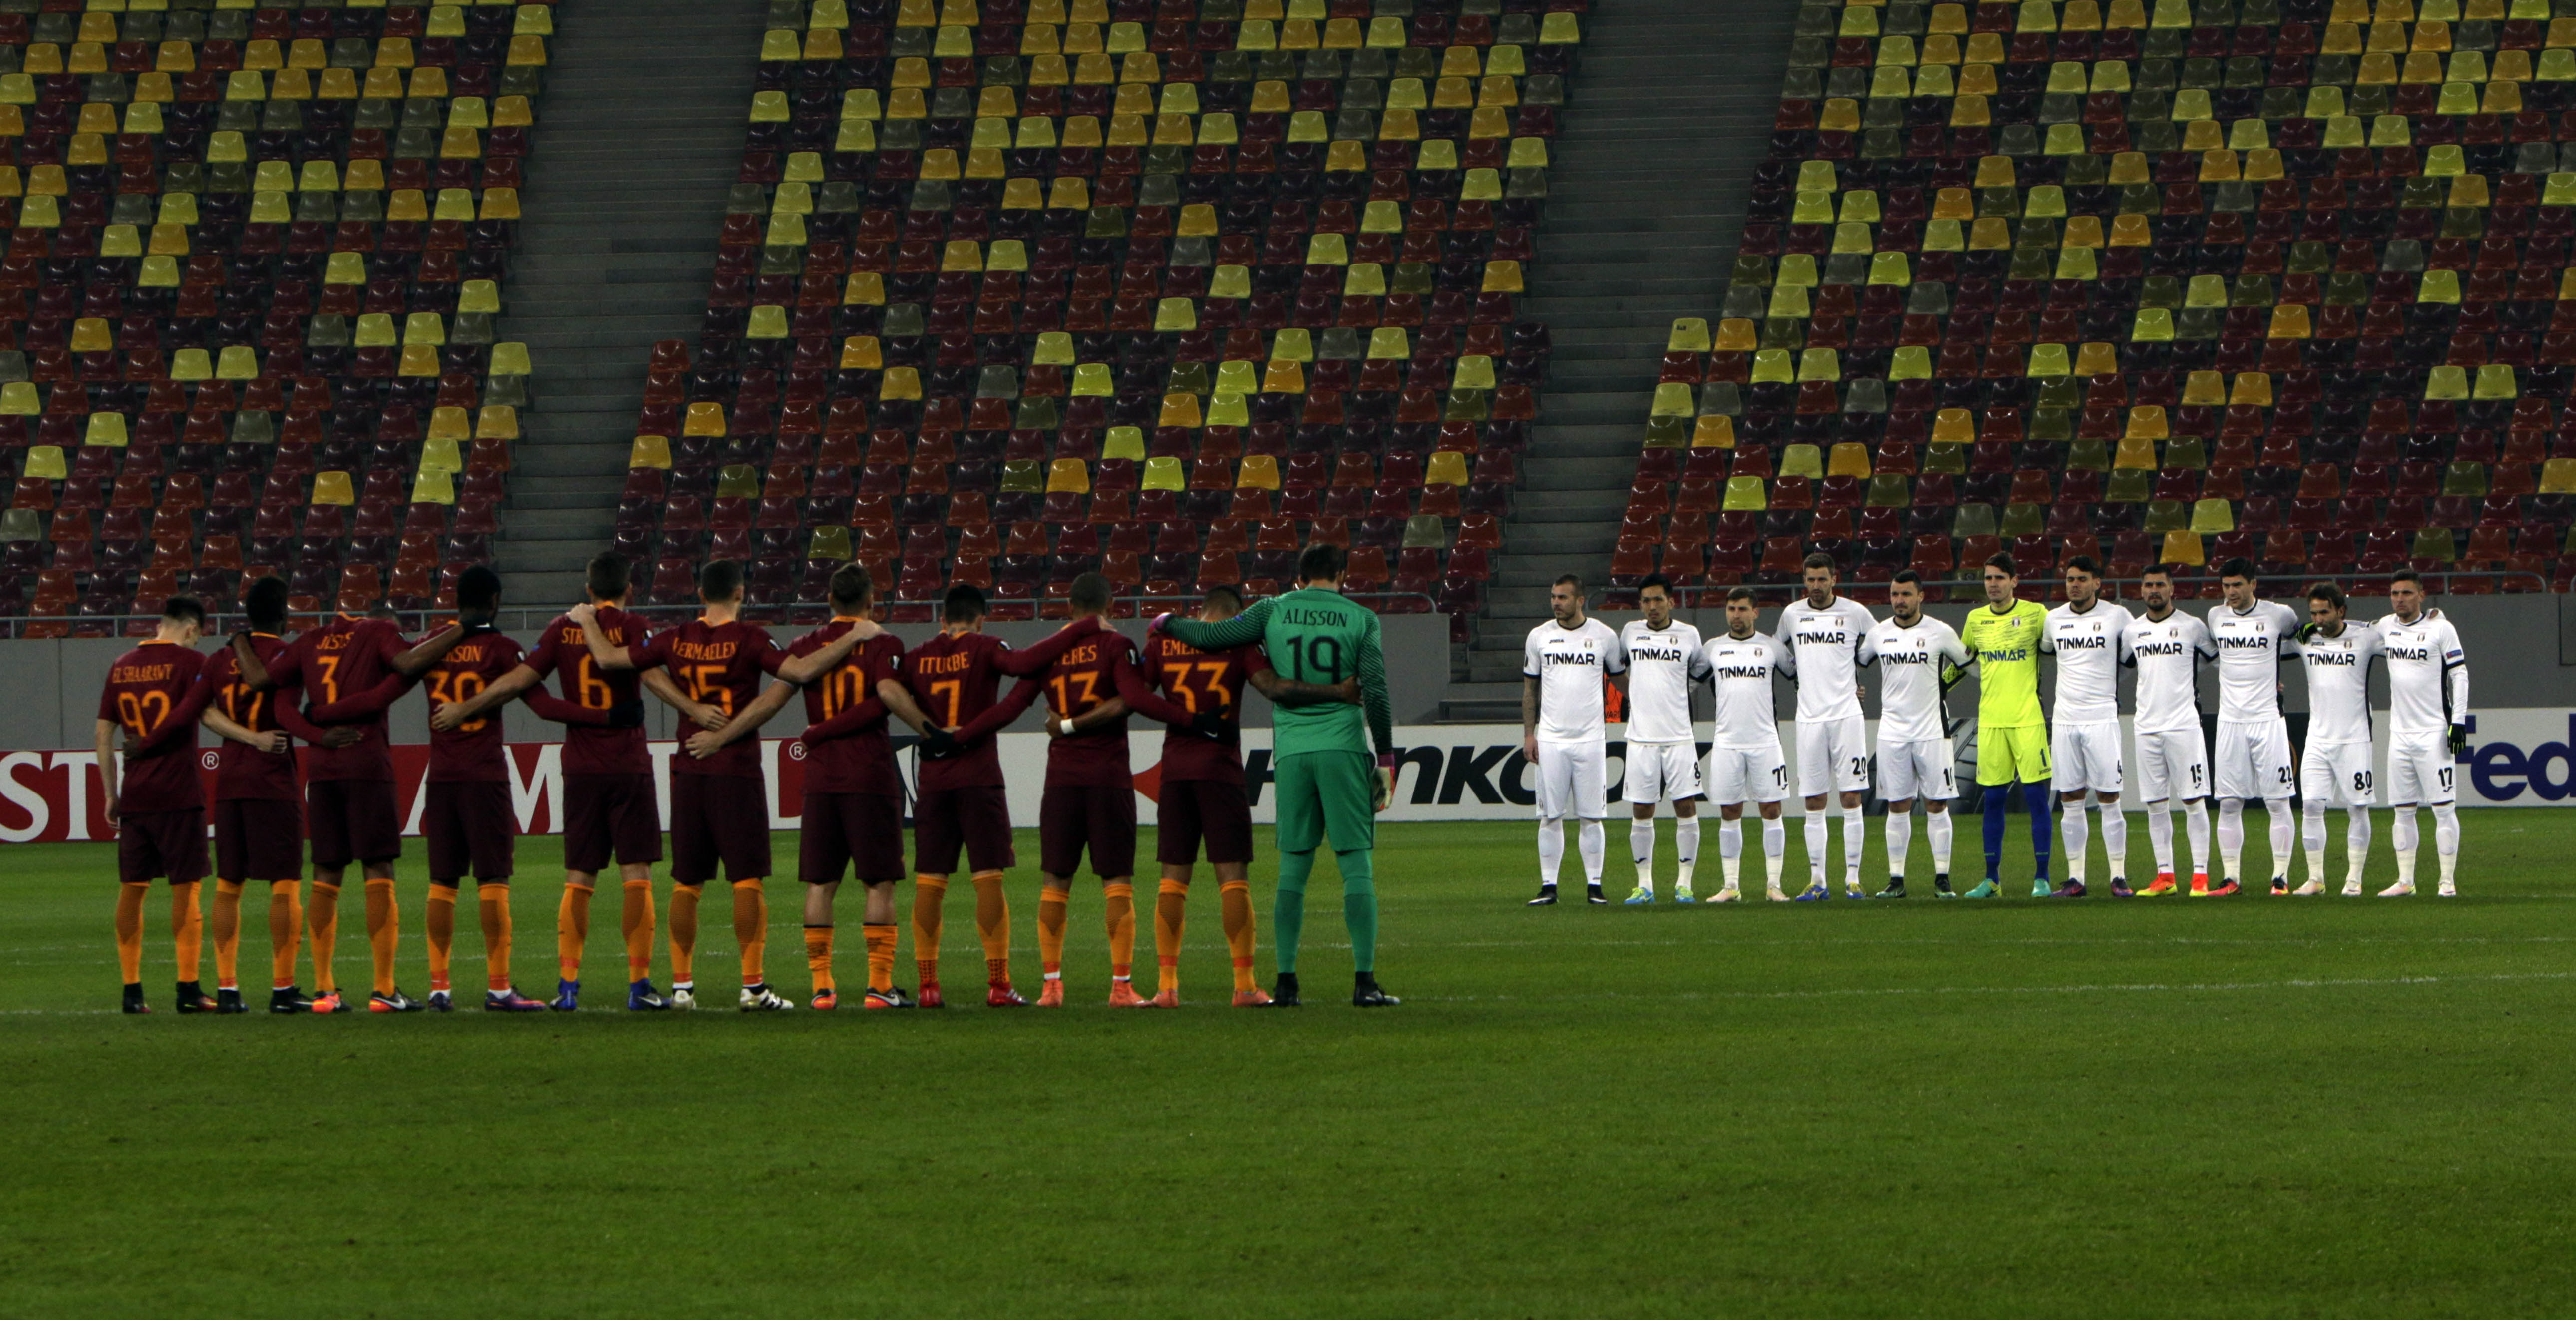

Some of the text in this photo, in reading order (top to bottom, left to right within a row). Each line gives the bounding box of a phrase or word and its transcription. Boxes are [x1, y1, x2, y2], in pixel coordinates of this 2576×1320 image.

[1282, 609, 1348, 627] ALISSON
[1796, 632, 1845, 645] TINMAR
[2056, 637, 2105, 650] TINMAR
[2218, 637, 2268, 649] TINMAR
[672, 637, 738, 661] VERMAELEN
[1054, 644, 1097, 666] ERES
[1631, 648, 1681, 662] TINMAR
[1880, 652, 1929, 665] TINMAR
[1981, 649, 2026, 662] TINMAR
[2136, 643, 2182, 658] TINMAR
[2386, 647, 2428, 661] TINMAR
[1287, 634, 1341, 684] 19
[1544, 653, 1595, 665] TINMAR
[2307, 653, 2355, 666] TINMAR
[317, 655, 341, 705] 3
[579, 652, 613, 710] 6
[1718, 666, 1766, 679] TINMAR
[679, 664, 732, 722] 15
[822, 664, 864, 721] 10
[1050, 670, 1105, 719] 13
[1163, 661, 1231, 719] 33
[424, 670, 488, 732] 30
[930, 679, 961, 727] 7
[118, 690, 171, 737] 92
[1852, 756, 1866, 775] 20
[2040, 748, 2047, 767] 1
[1694, 762, 1701, 779] 8
[1772, 765, 1787, 786] 77
[2354, 770, 2372, 790] 80
[2438, 767, 2452, 787] 17
